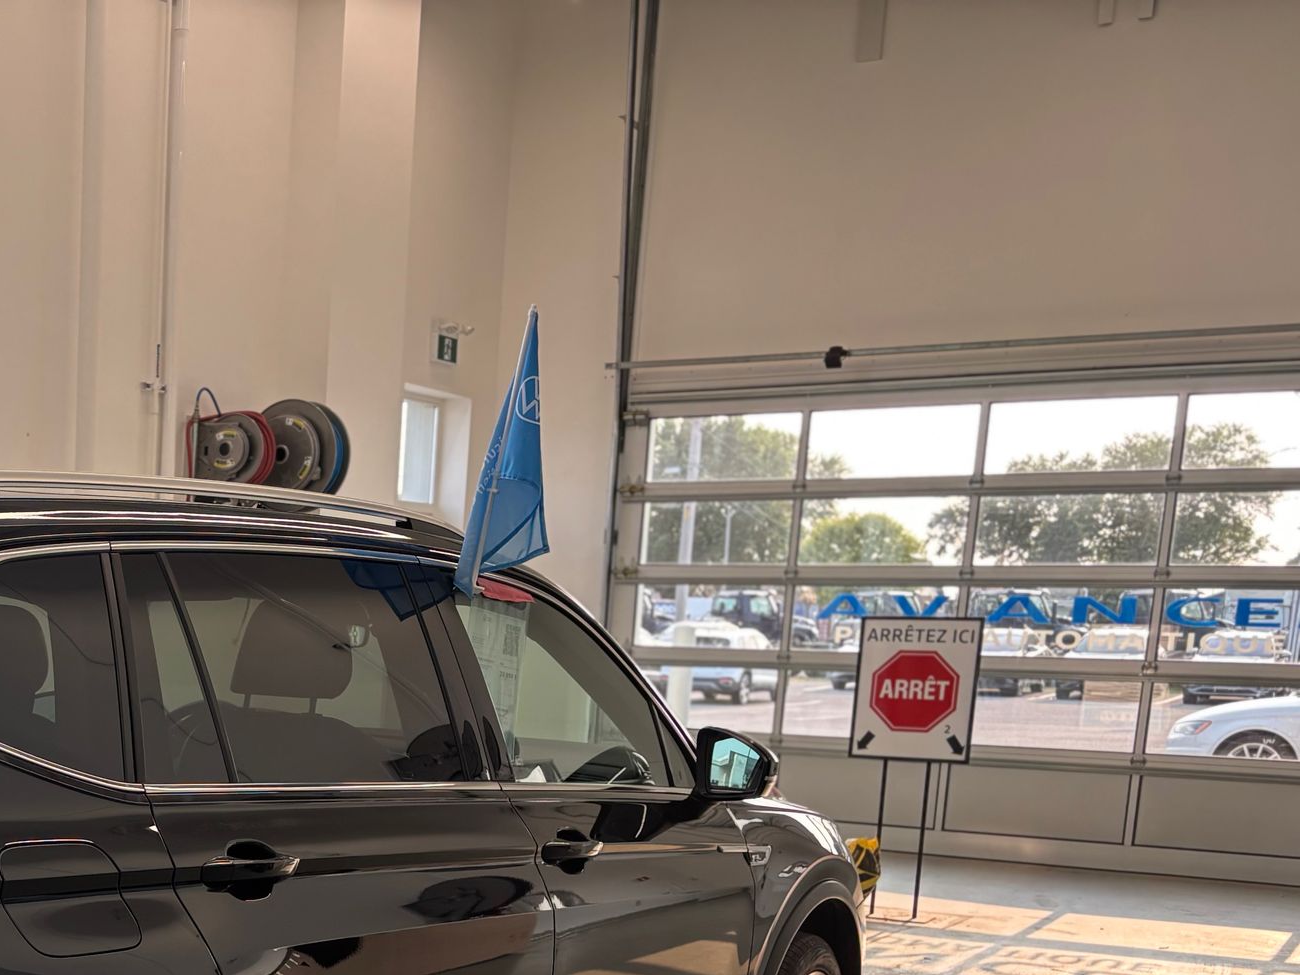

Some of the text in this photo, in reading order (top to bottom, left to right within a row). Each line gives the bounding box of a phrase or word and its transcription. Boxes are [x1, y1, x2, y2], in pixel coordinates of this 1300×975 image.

[817, 592, 1300, 628] AVANCE
[867, 625, 947, 643] ARRÊTEZ
[952, 629, 976, 644] ICI
[878, 675, 950, 701] ARRÊT
[943, 725, 951, 734] 2
